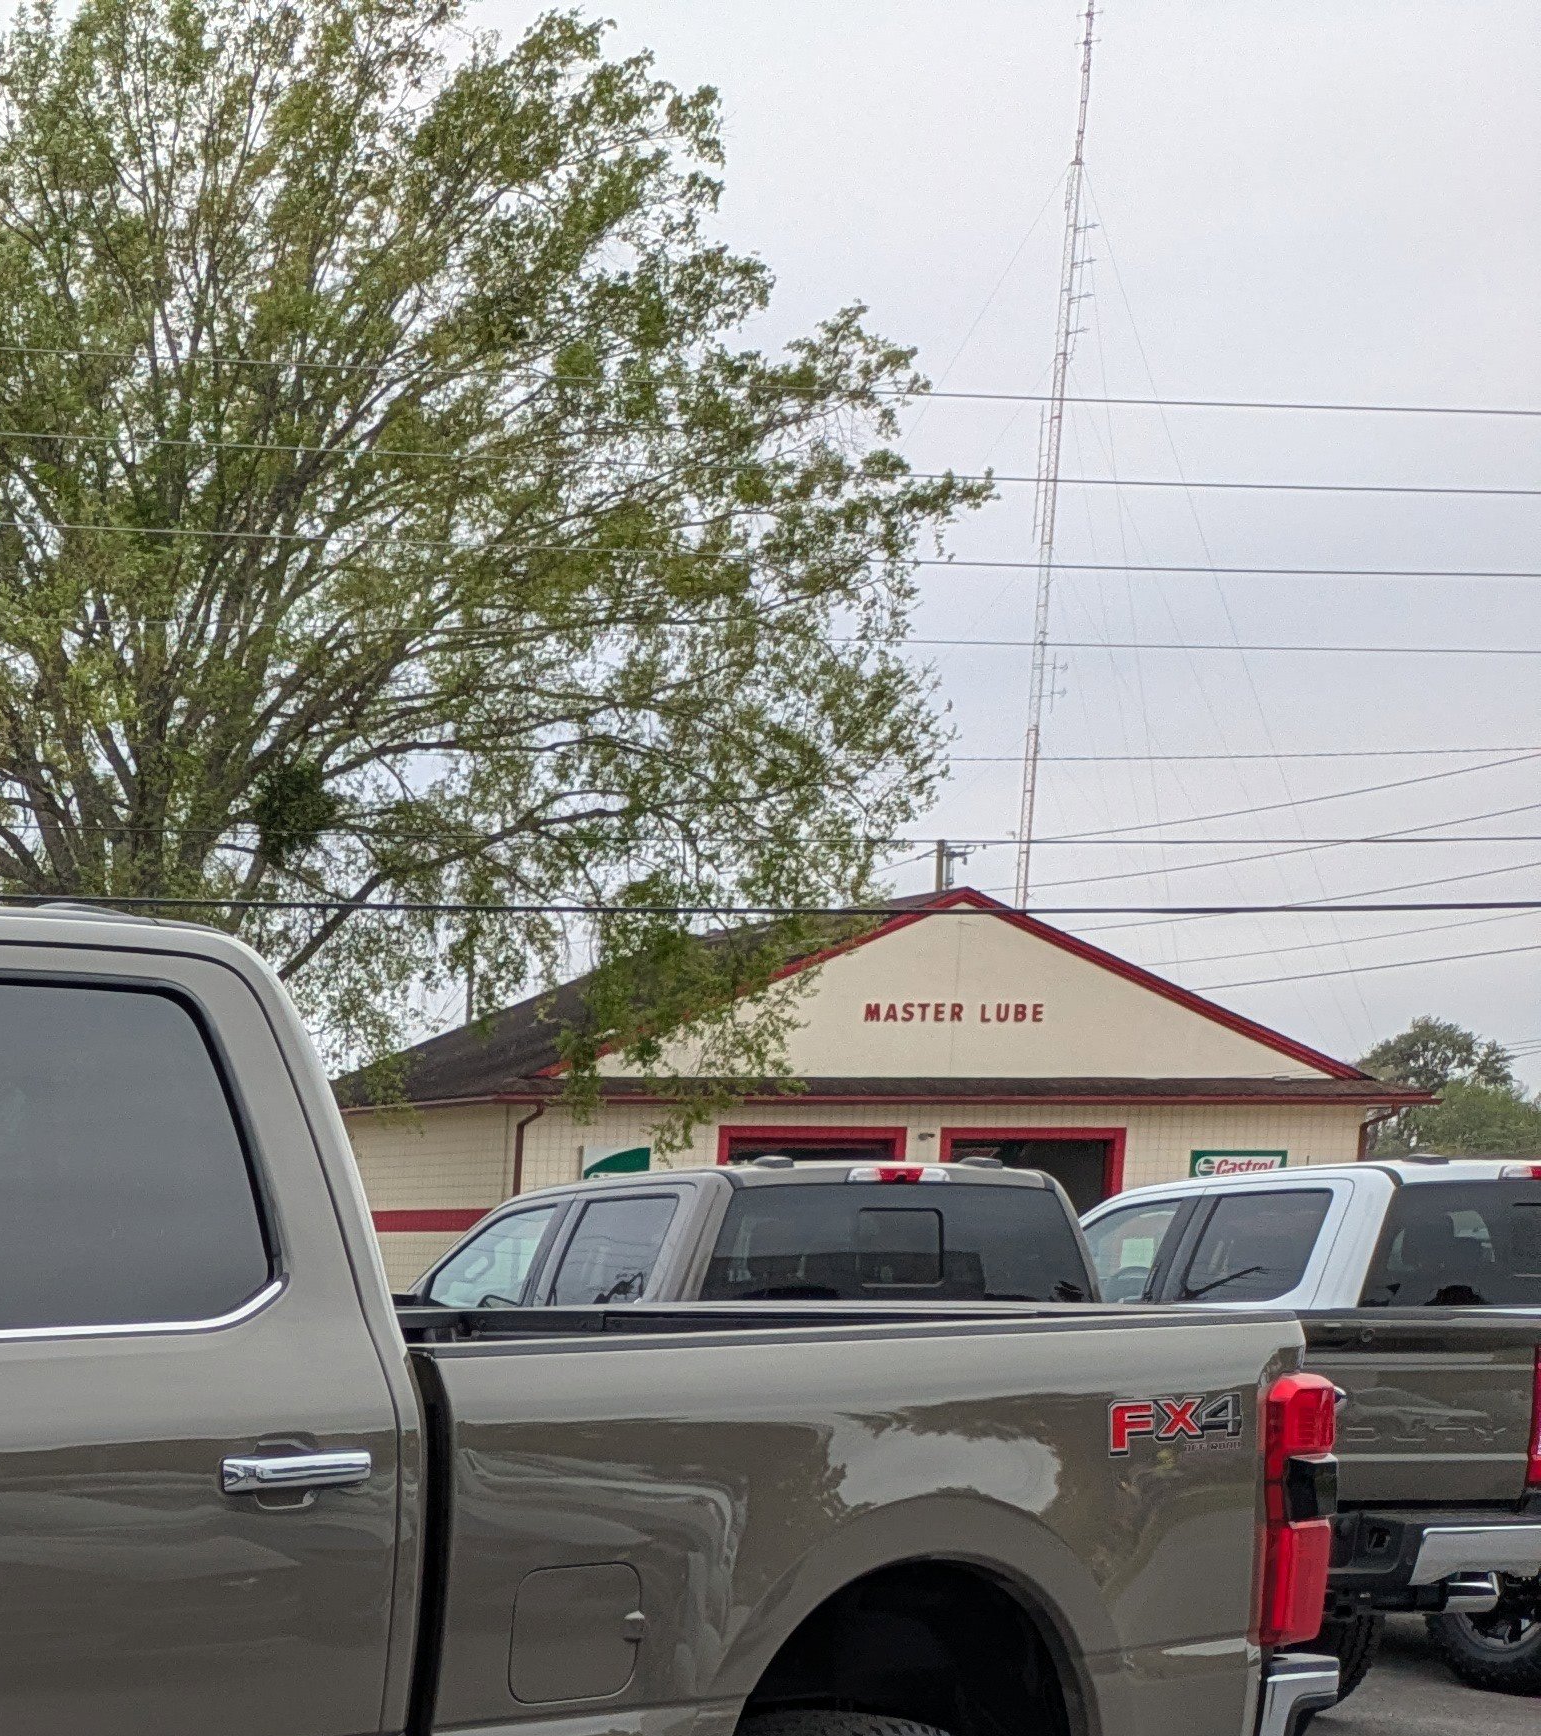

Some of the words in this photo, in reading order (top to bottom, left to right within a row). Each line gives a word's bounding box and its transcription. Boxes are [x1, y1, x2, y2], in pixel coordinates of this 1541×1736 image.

[864, 1003, 964, 1022] MASTER
[980, 1003, 1044, 1022] LUBE
[1216, 1159, 1275, 1175] Castrol
[1108, 1392, 1243, 1458] FX4
